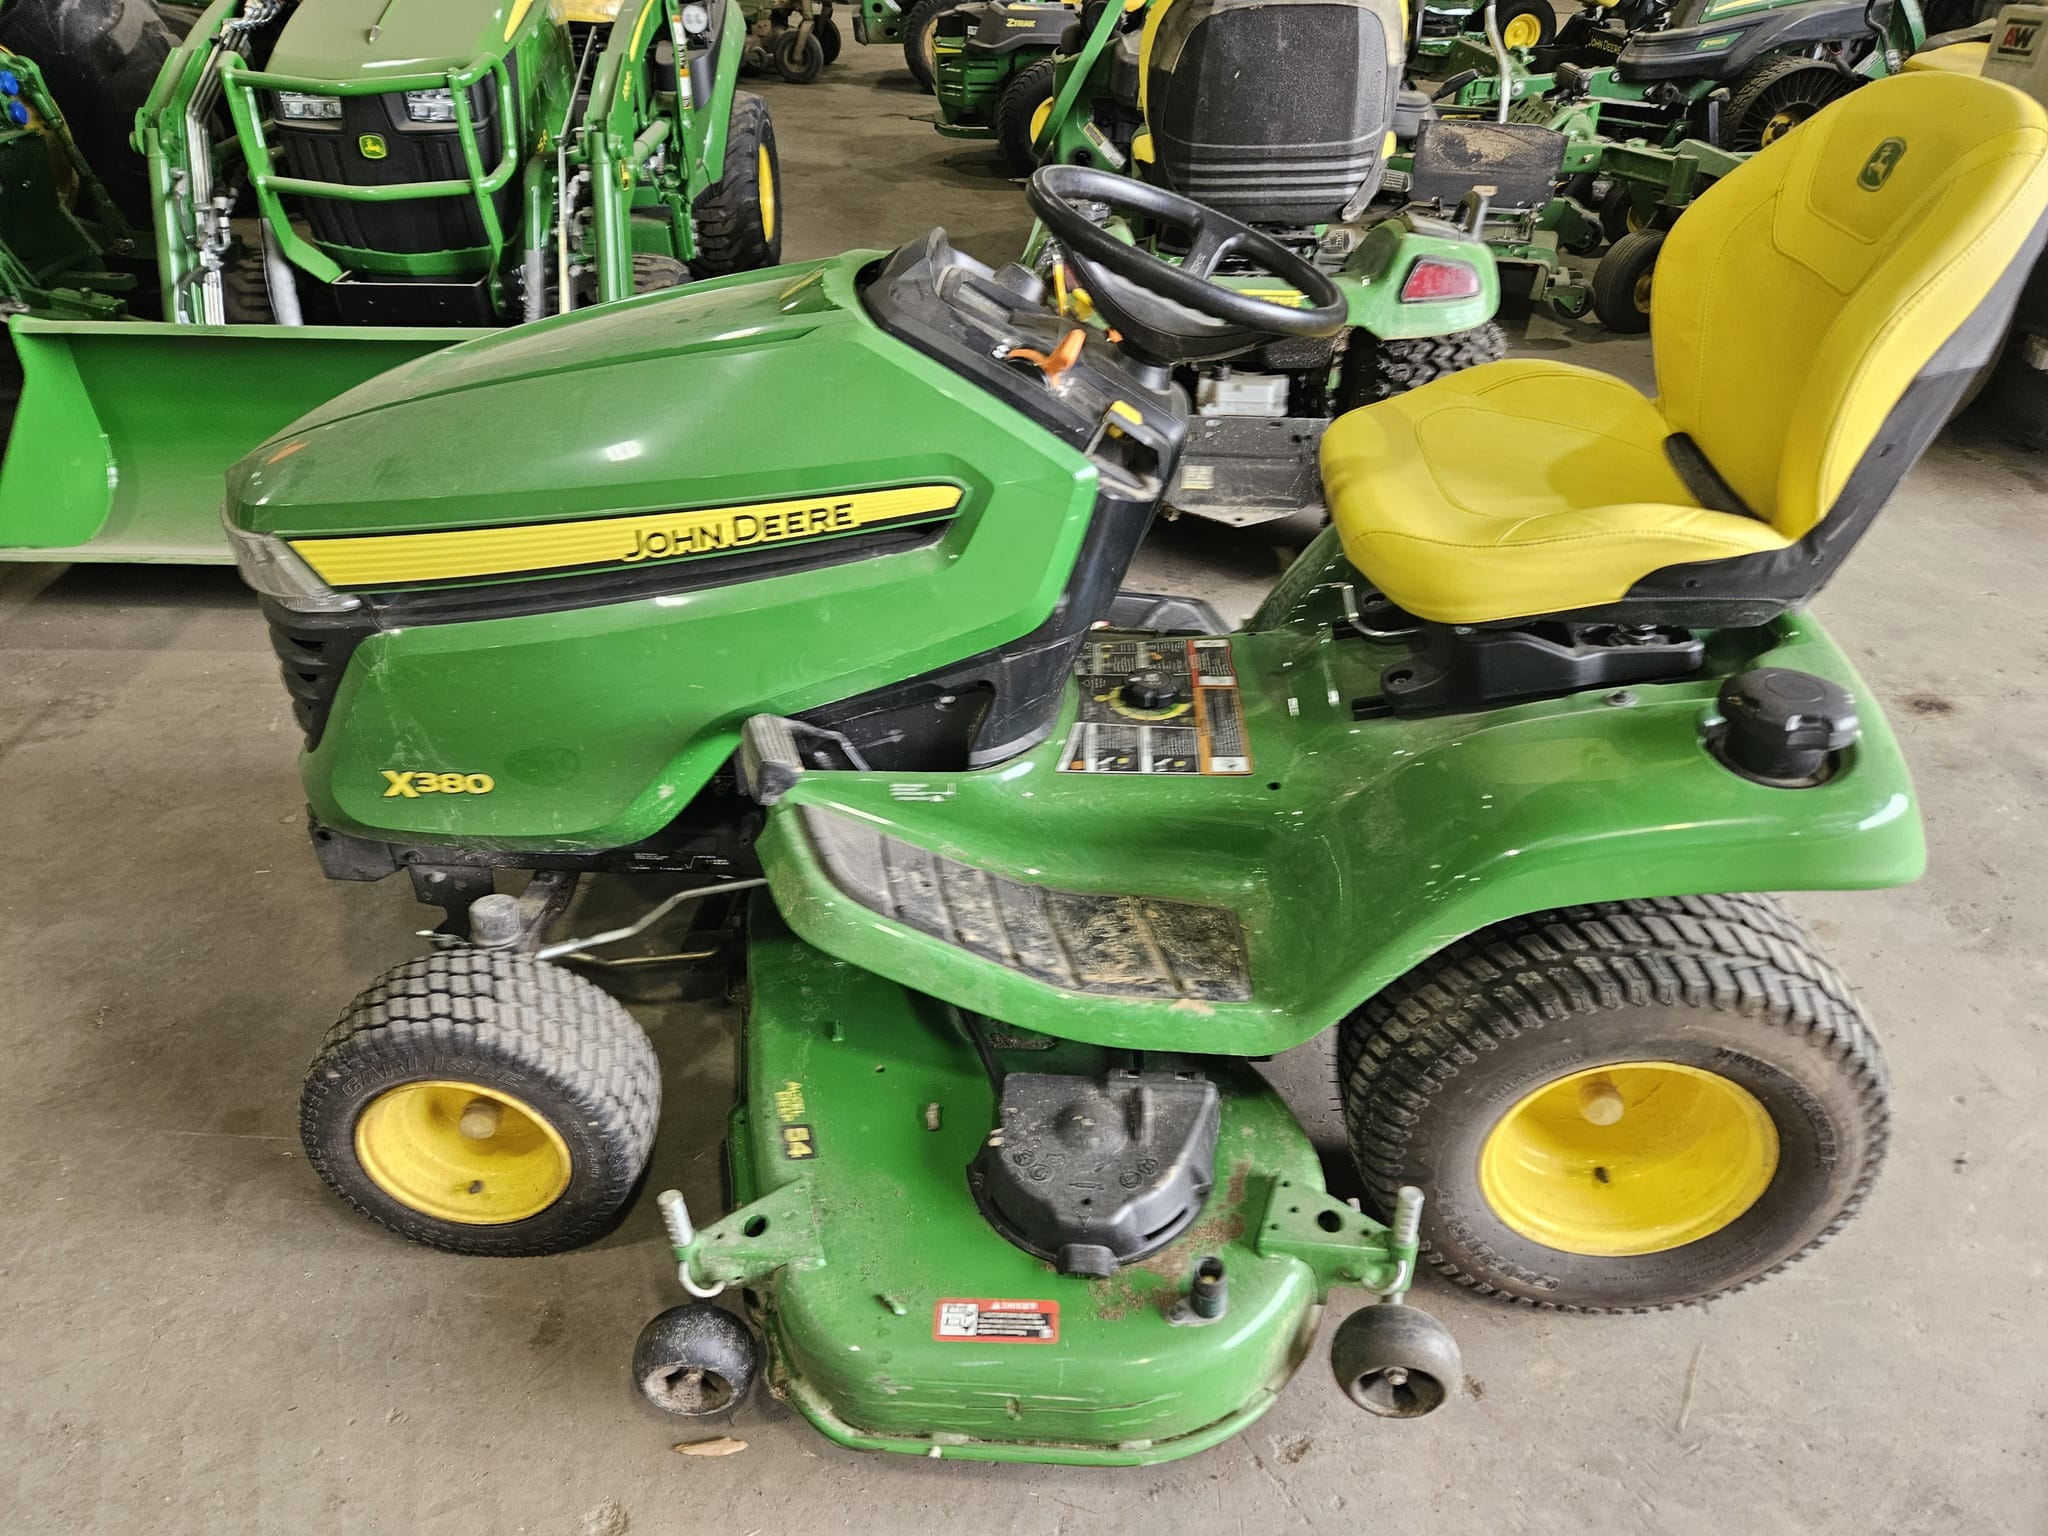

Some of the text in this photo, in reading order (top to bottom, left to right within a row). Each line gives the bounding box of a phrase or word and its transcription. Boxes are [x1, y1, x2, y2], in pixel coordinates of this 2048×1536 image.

[1006, 18, 1036, 28] ZTRAK
[623, 502, 857, 561] JOHN DEERE
[379, 769, 495, 798] X380
[341, 1054, 526, 1098] CARLISLE
